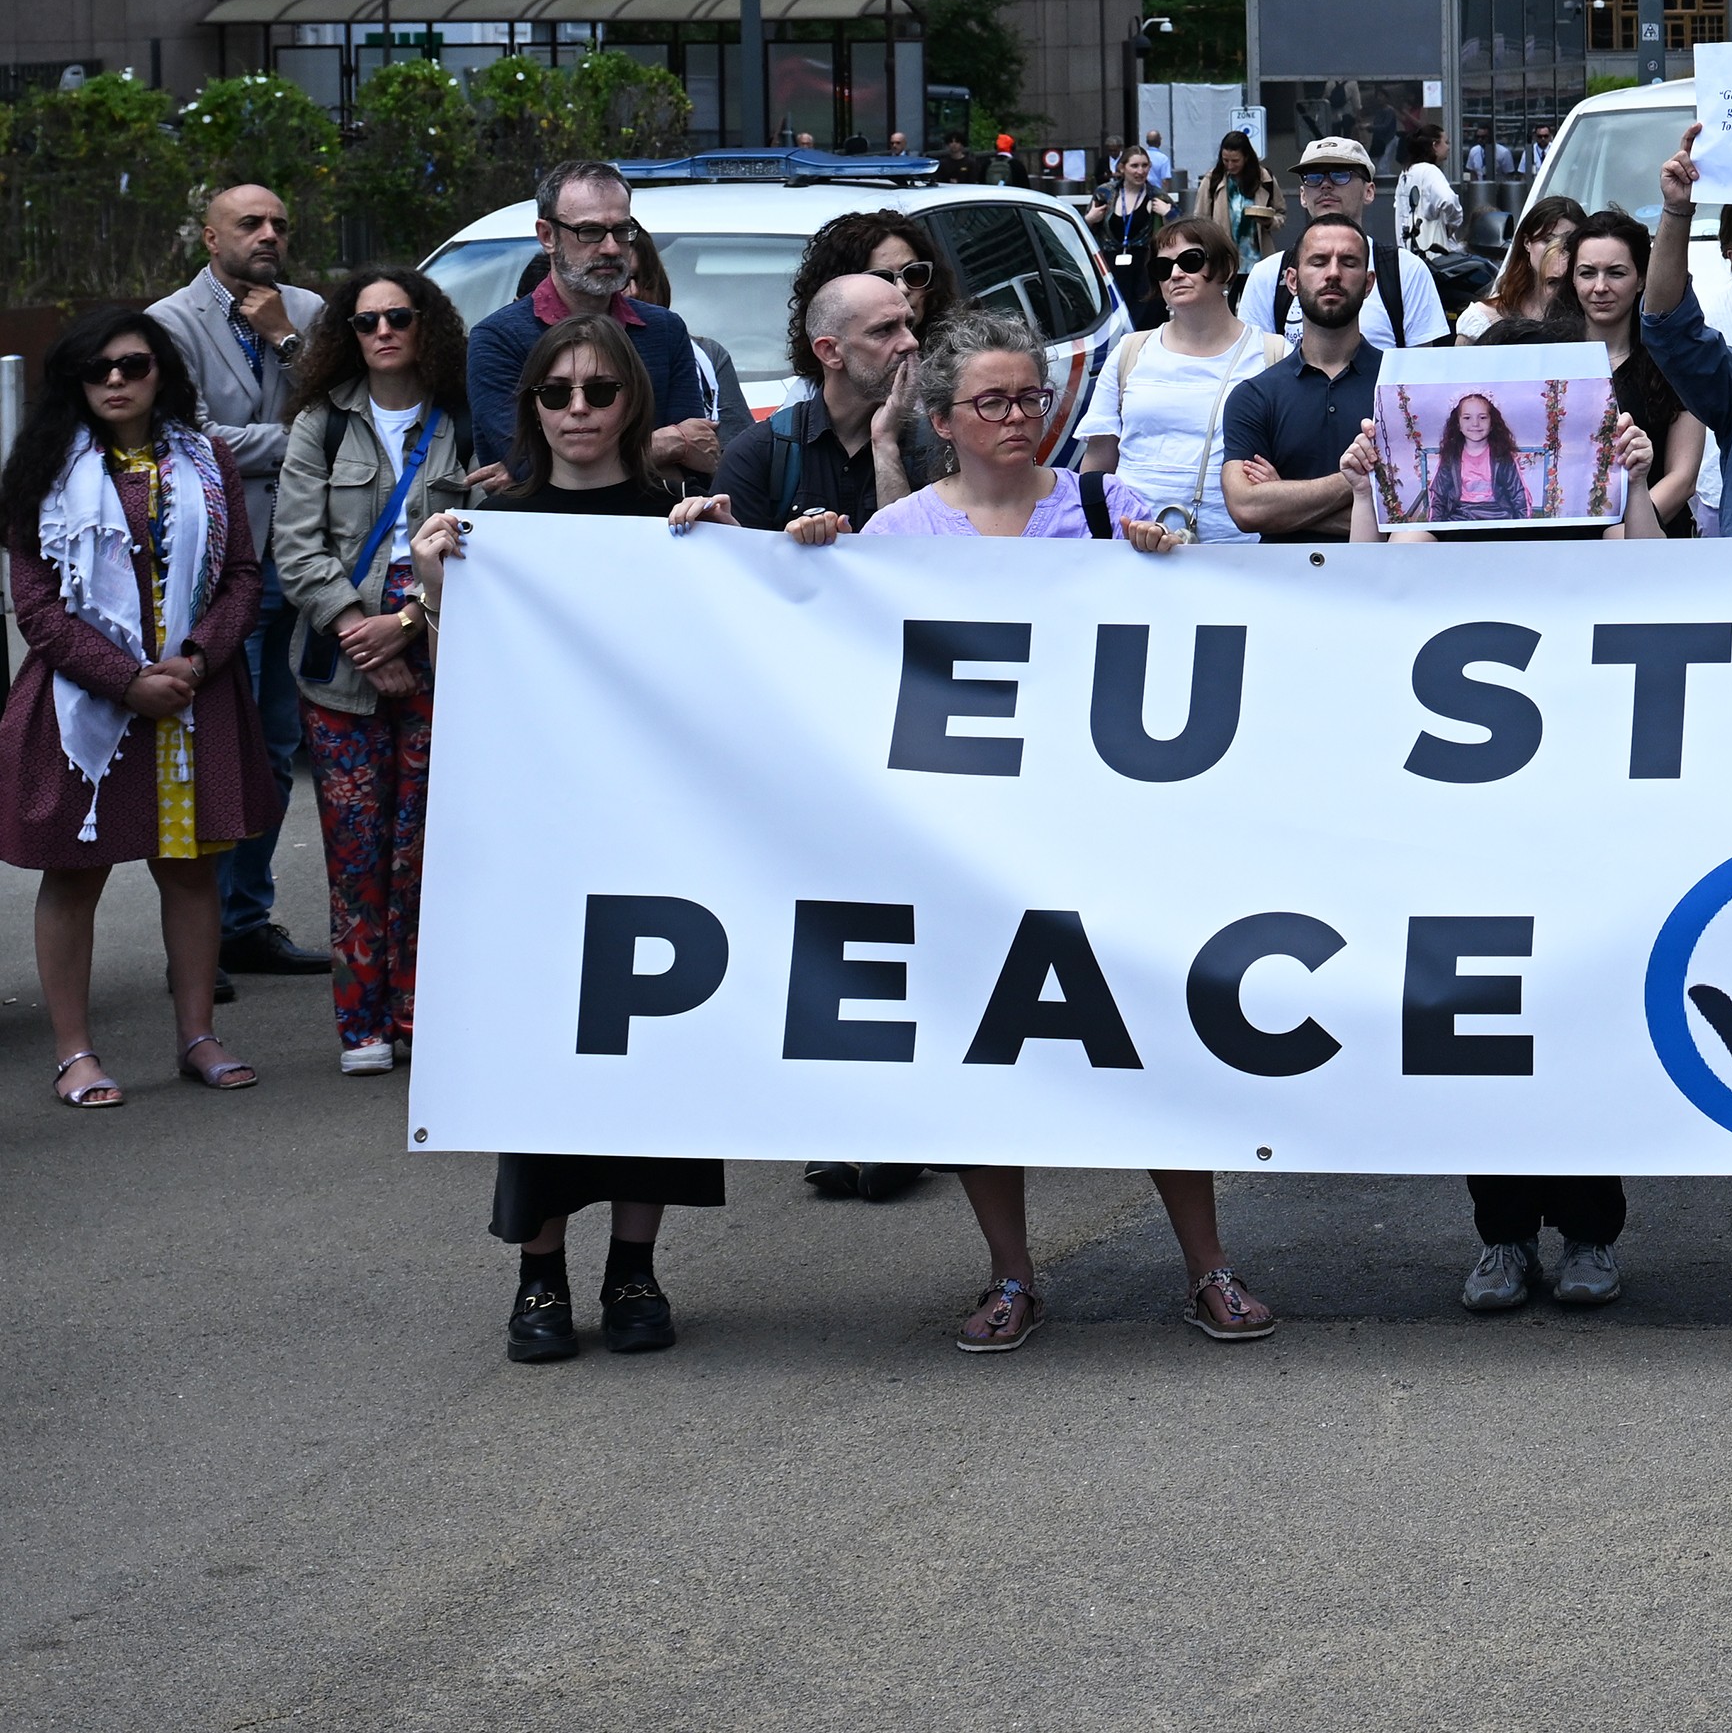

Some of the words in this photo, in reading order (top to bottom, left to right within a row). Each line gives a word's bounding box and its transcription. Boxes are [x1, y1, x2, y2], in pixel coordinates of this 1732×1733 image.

[1237, 111, 1256, 119] ZONE
[888, 620, 1247, 783] EU
[576, 894, 1534, 1077] PEACE
